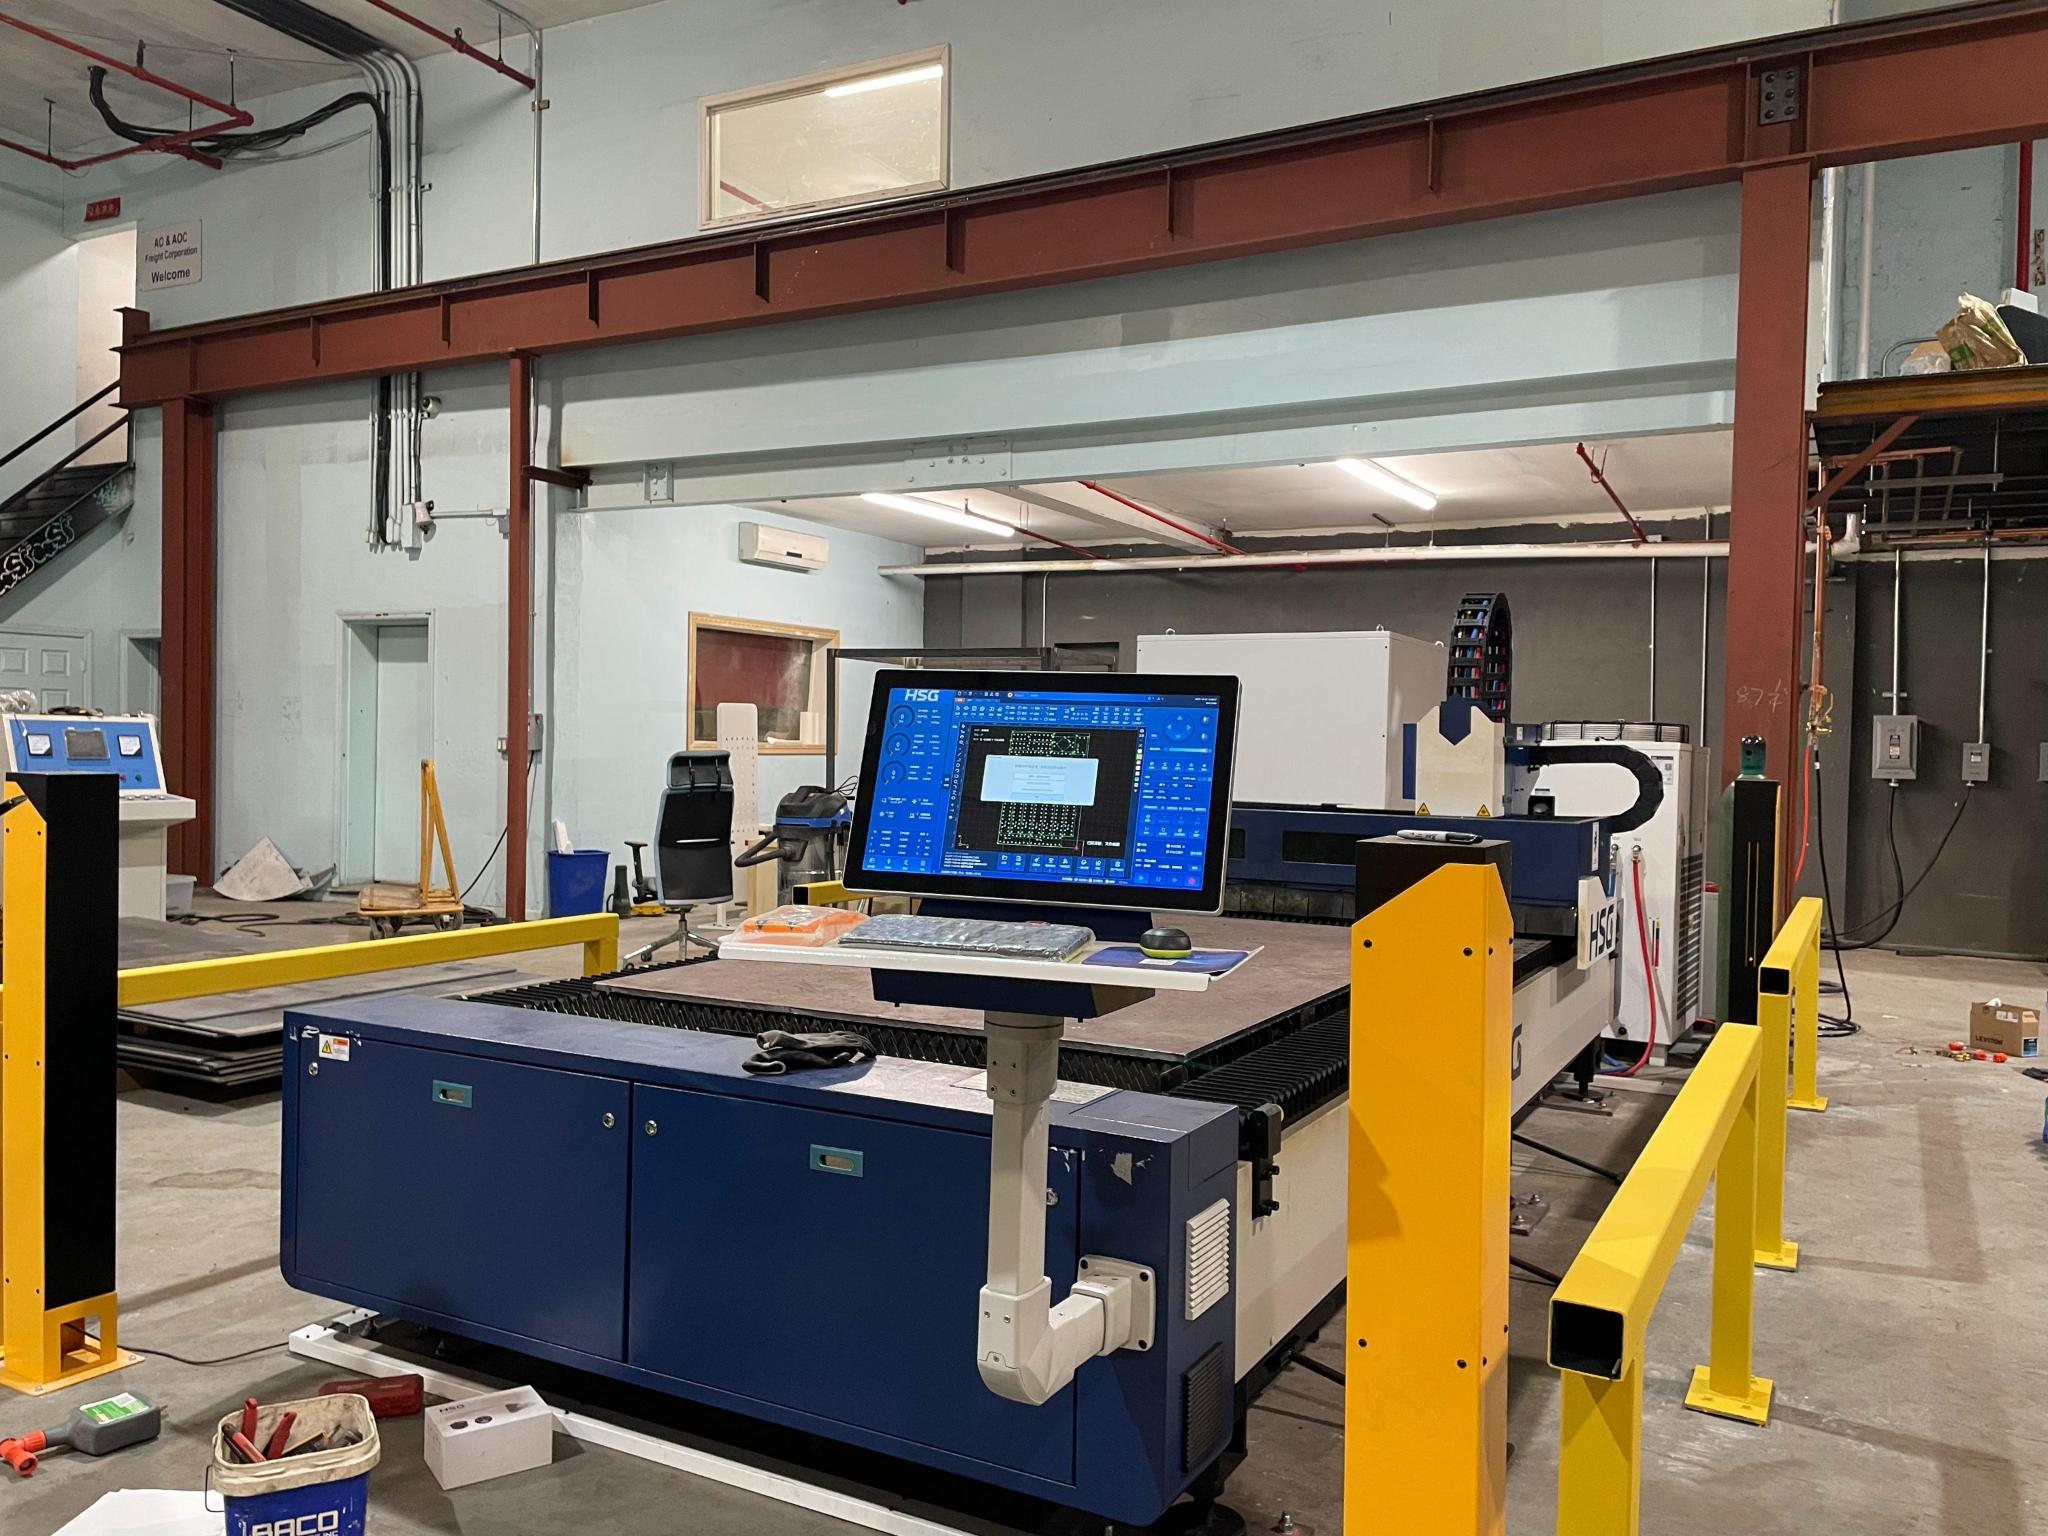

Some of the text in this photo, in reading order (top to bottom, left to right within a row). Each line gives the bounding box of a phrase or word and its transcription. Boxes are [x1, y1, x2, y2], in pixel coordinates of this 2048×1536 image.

[145, 247, 198, 264] Freight Corporation
[151, 268, 191, 284] Welcome
[904, 689, 940, 701] HSG
[1589, 903, 1615, 962] HSG
